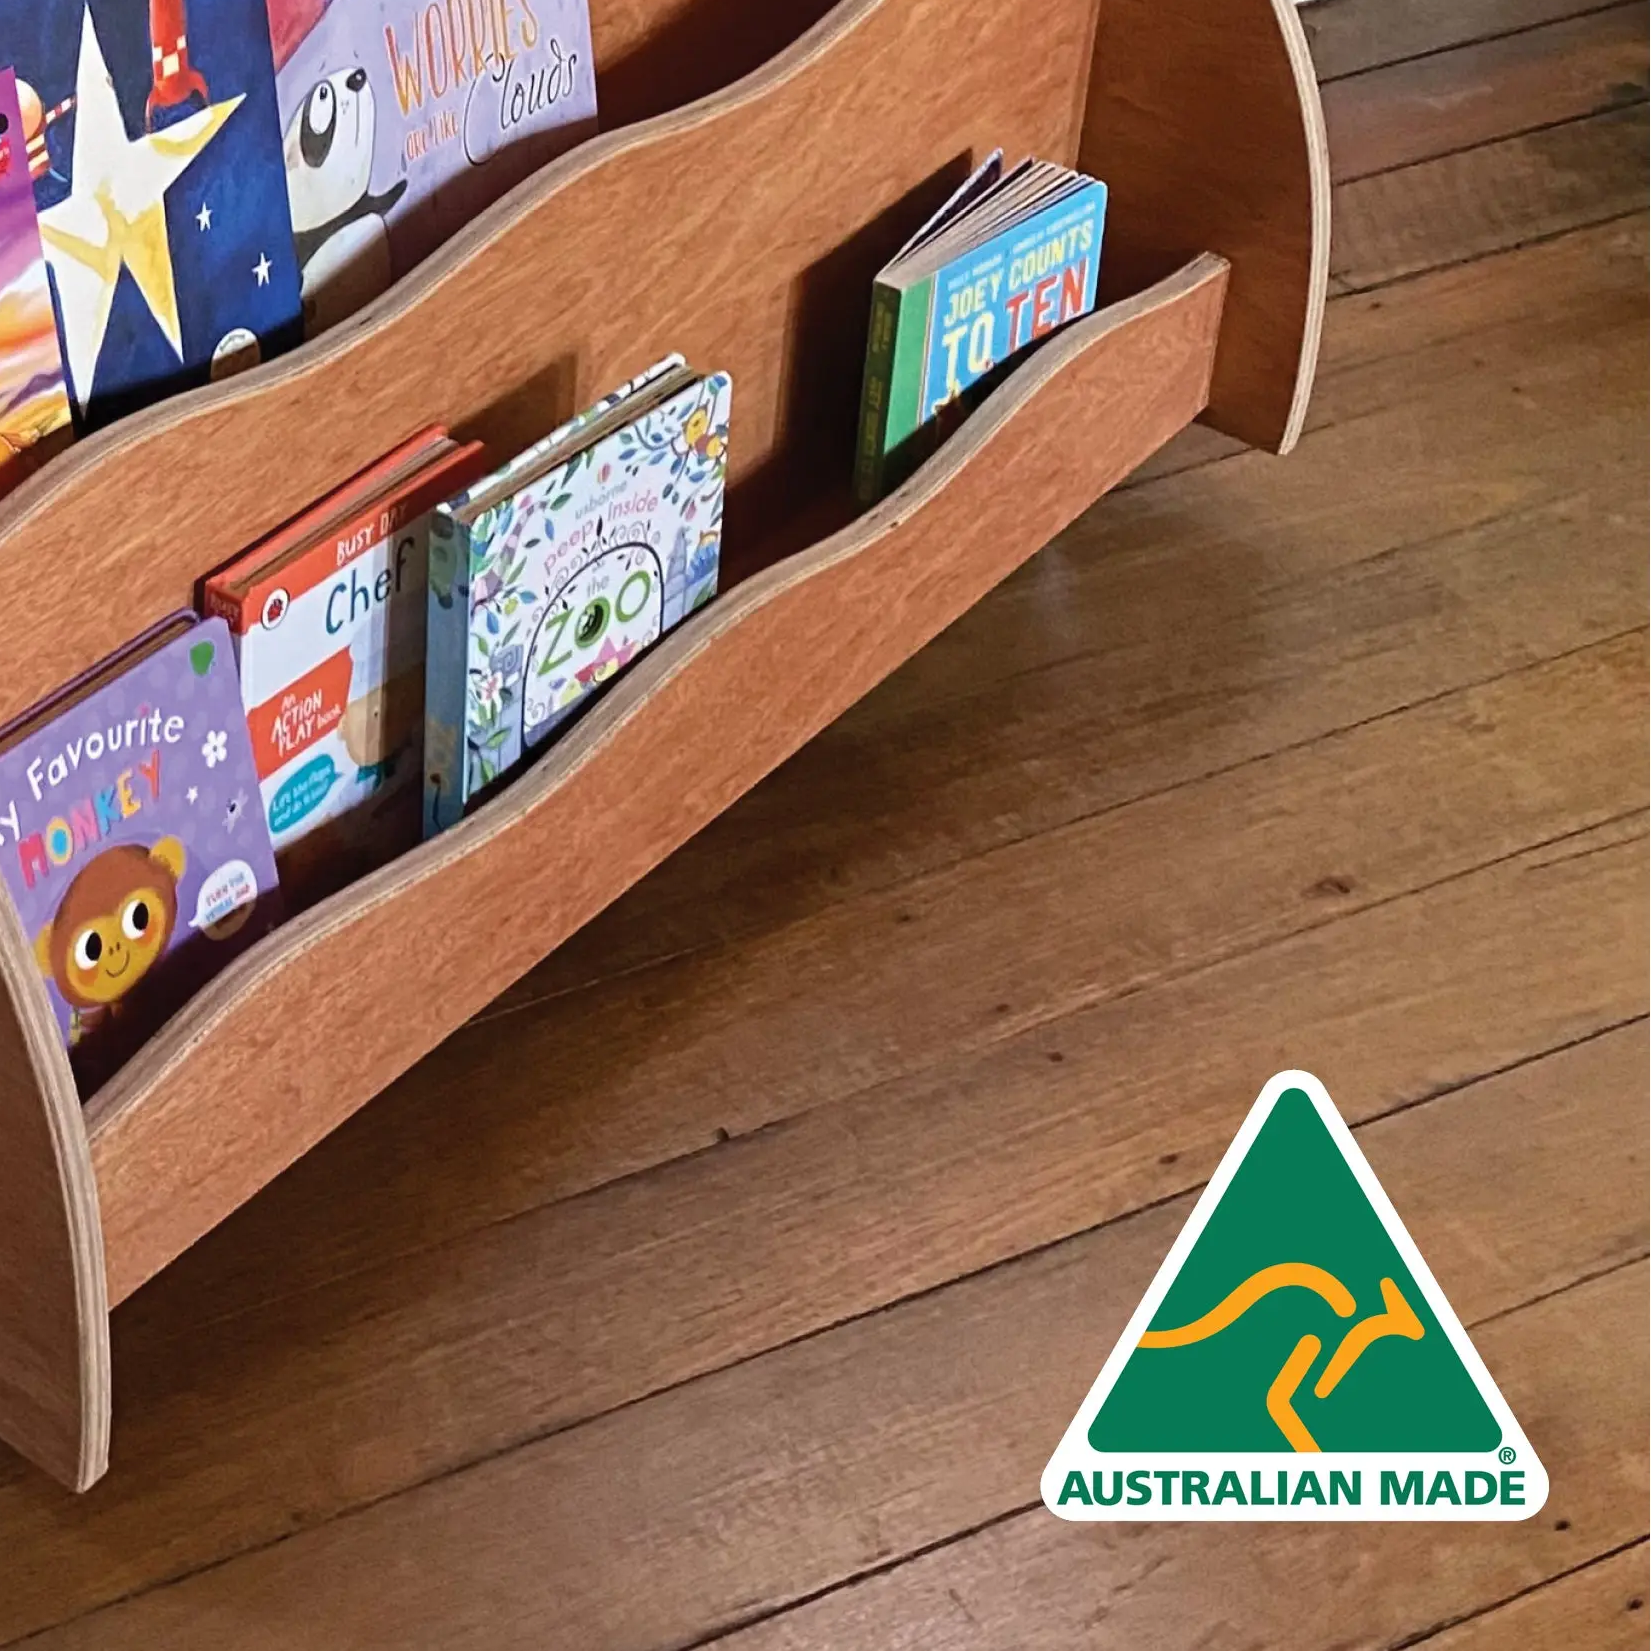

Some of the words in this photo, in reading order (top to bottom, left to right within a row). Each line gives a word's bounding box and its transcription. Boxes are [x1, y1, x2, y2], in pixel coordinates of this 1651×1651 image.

[464, 37, 578, 166] Clouds
[943, 268, 1005, 327] JOEY
[1009, 219, 1096, 292] COUNTS
[1005, 255, 1091, 354] TEN
[336, 522, 375, 566] BUSY
[575, 480, 628, 519] usborne
[326, 535, 415, 635] Chef
[544, 520, 593, 576] peep
[26, 708, 186, 802] Favourite
[271, 688, 323, 744] ACTION
[278, 713, 315, 758] PLAY
[17, 750, 162, 891] MONKEY
